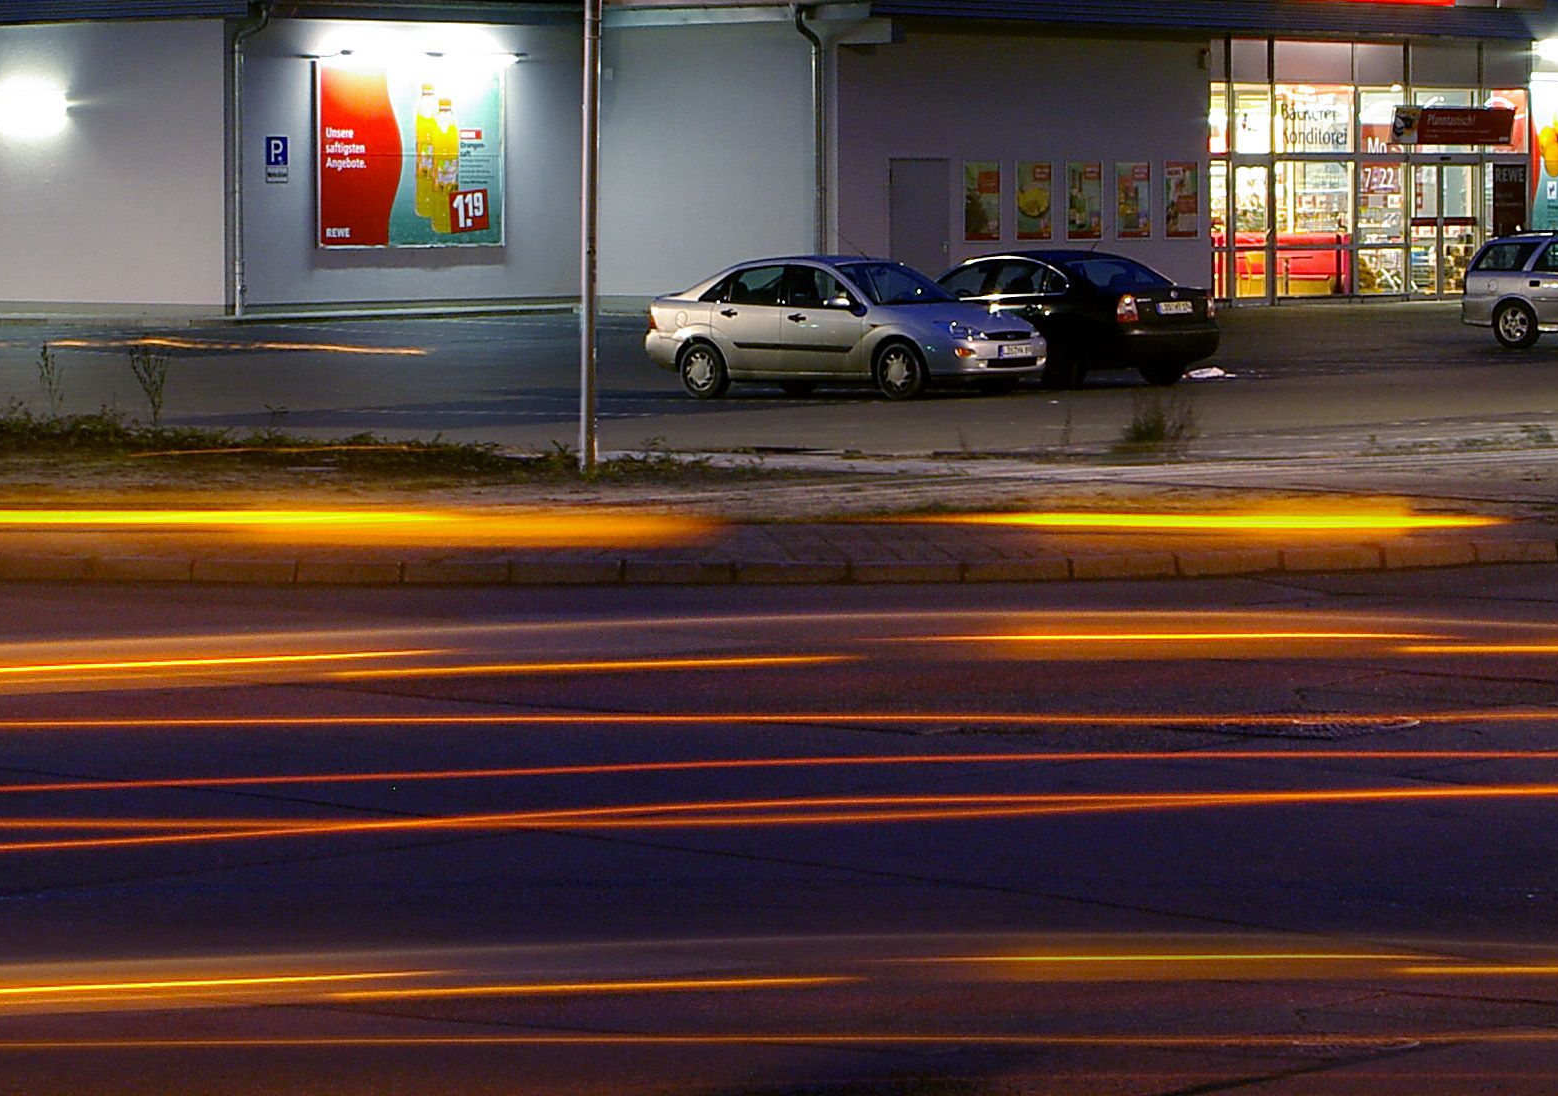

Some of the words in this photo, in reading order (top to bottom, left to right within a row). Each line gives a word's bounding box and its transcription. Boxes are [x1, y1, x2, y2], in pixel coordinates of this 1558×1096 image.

[325, 127, 354, 139] Unsere
[325, 142, 366, 156] saftigsten
[1366, 135, 1389, 154] Mo
[325, 156, 367, 172] Angebote.
[1495, 167, 1525, 184] REWE
[453, 192, 484, 228] 1.19
[325, 227, 351, 238] REWE
